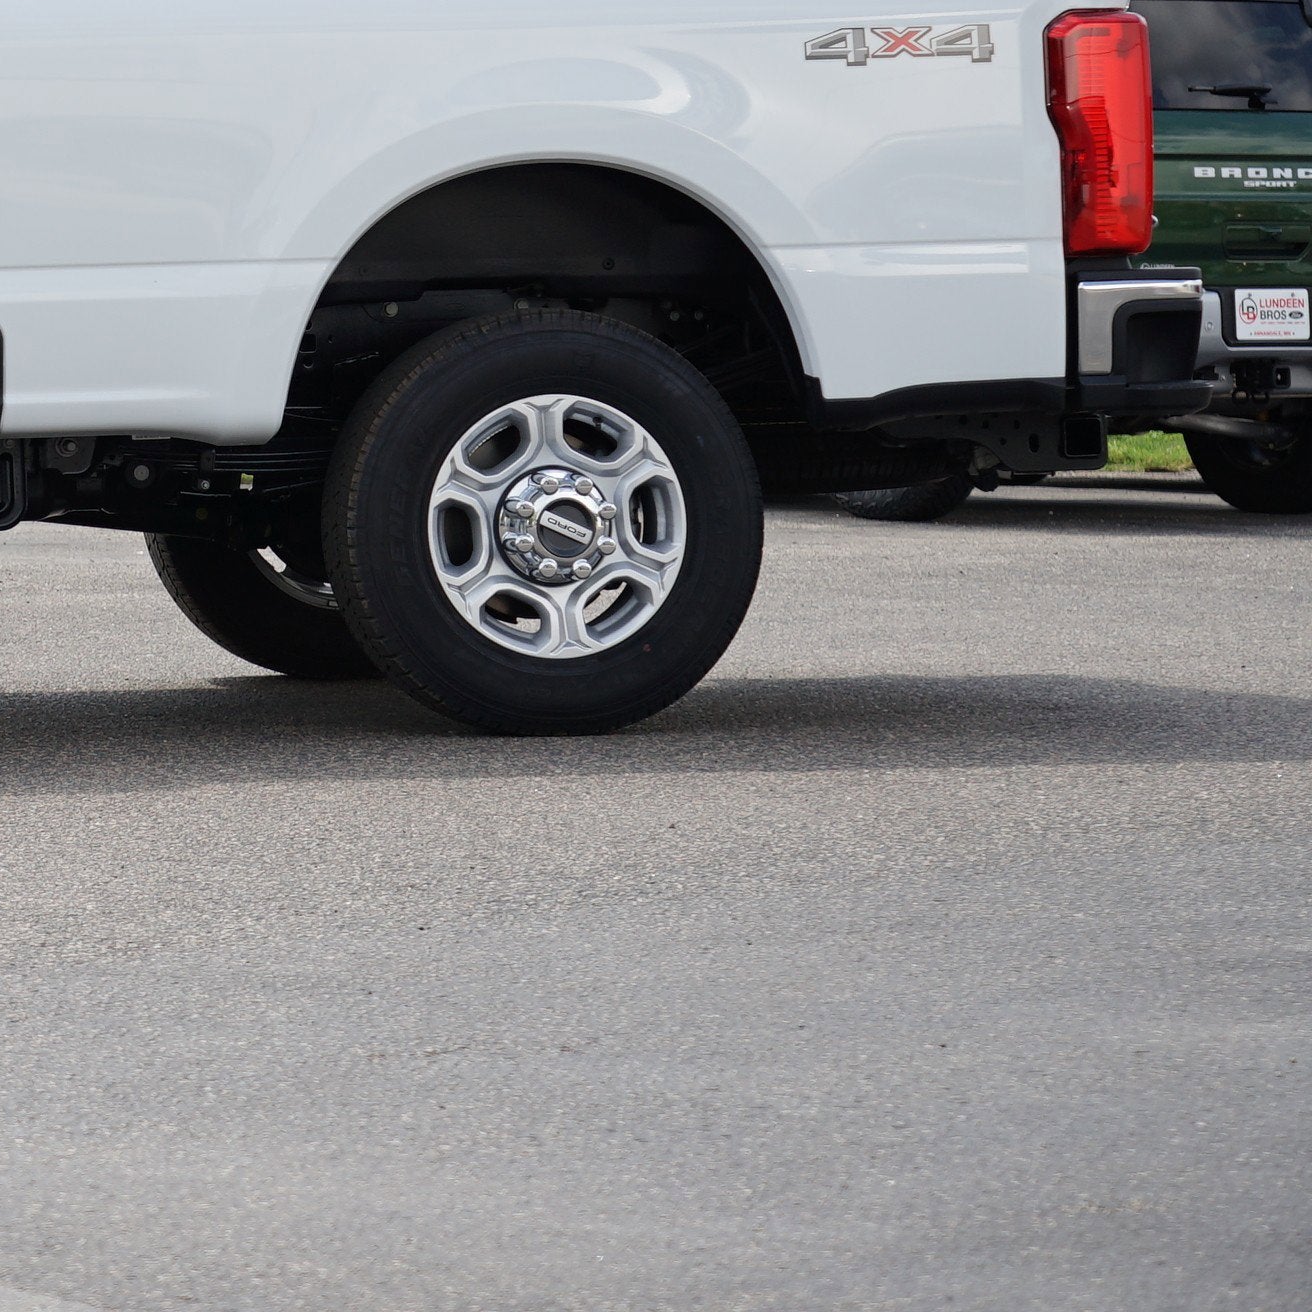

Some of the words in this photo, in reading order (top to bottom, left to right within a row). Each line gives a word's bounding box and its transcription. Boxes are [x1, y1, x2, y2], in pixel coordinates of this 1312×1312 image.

[1244, 180, 1297, 188] SPORT
[1259, 298, 1305, 308] LUNDEEN
[1260, 310, 1287, 320] BROS
[548, 518, 585, 537] FORD
